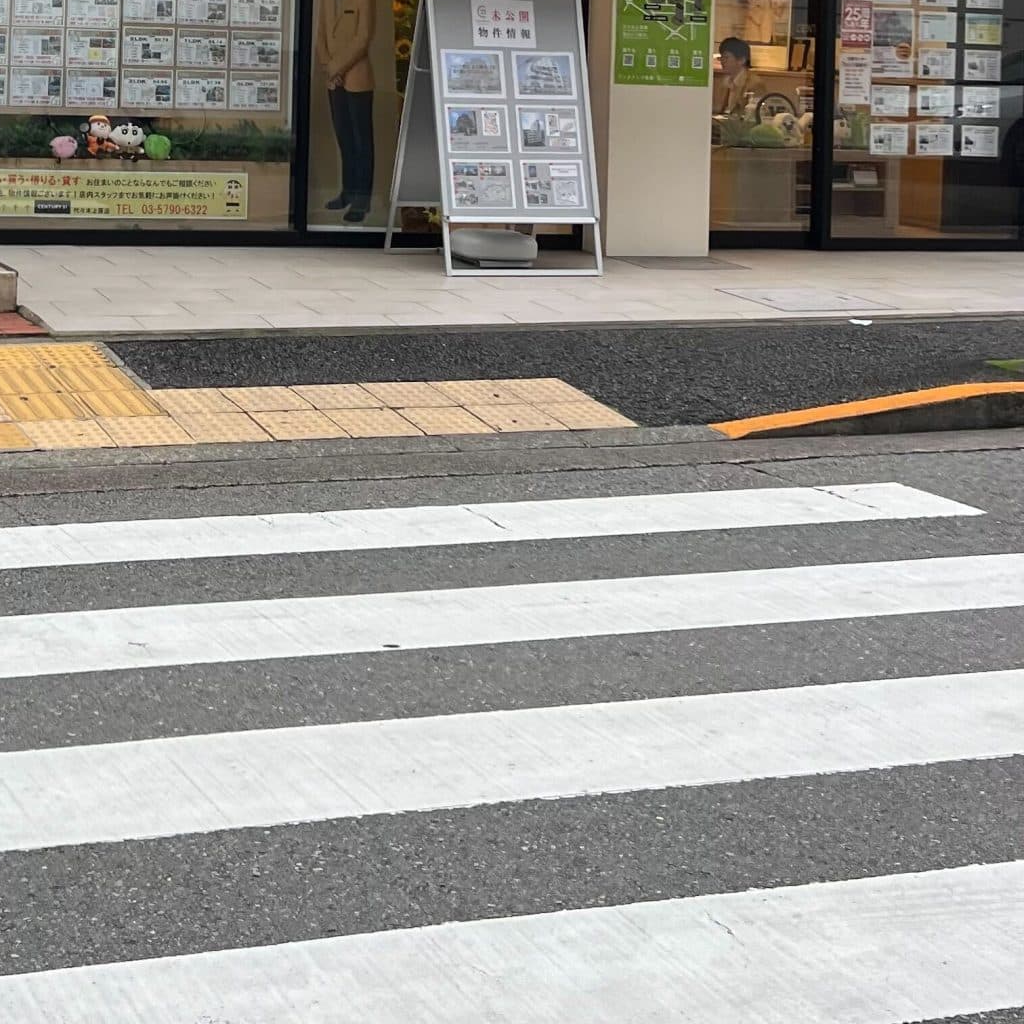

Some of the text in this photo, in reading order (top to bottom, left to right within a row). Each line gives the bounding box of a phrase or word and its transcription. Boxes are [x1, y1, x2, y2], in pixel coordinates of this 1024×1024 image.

[478, 26, 531, 40] 物件情報
[116, 204, 208, 215] TEL 03-5790-6322
